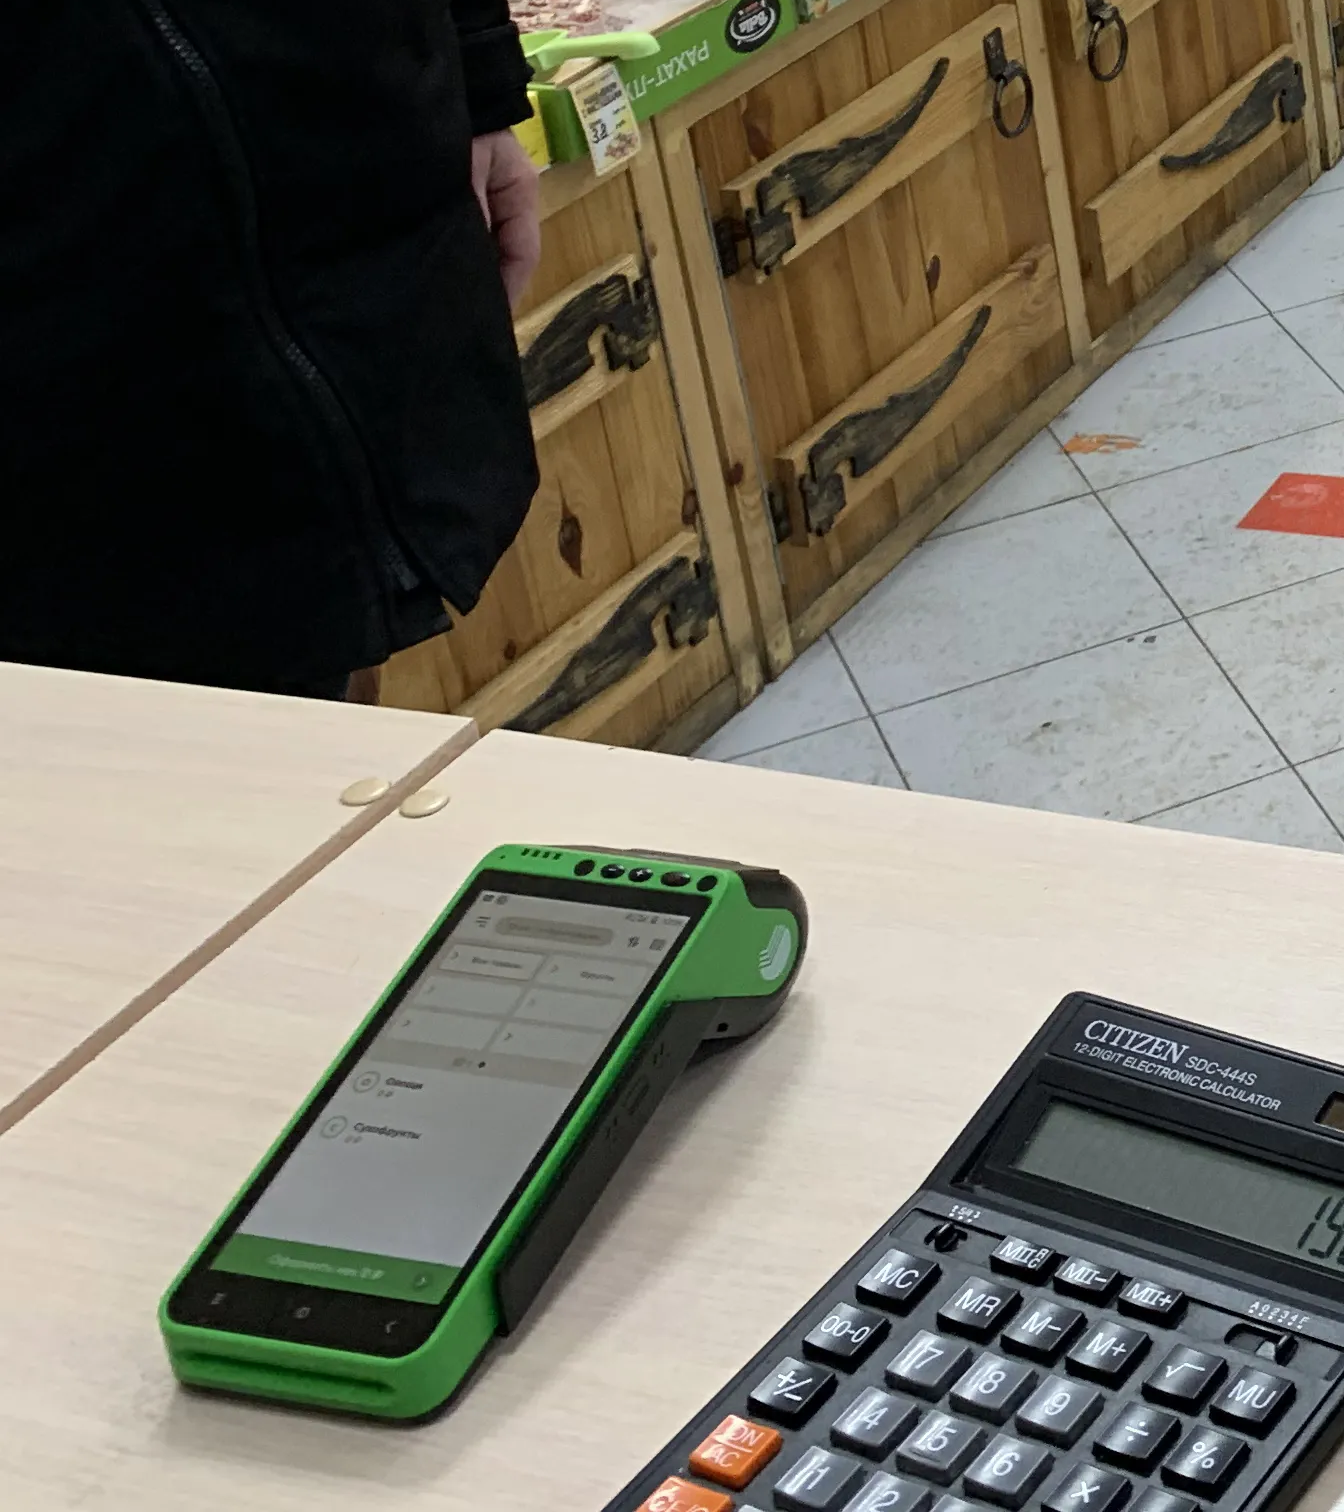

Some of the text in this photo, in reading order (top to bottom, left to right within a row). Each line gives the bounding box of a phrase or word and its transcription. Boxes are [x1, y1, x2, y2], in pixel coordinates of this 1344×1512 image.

[1083, 1019, 1258, 1087] CITIZEN SDC-444S
[1072, 1041, 1282, 1112] 12-DIGIT ELECTRONIC CALCULATOR
[875, 1262, 919, 1290] MC
[954, 1288, 1002, 1317] MR
[820, 1315, 870, 1343] 00-0
[1086, 1333, 1127, 1358] M+
[1045, 1391, 1071, 1417] 9
[1228, 1379, 1277, 1410] MU
[703, 1445, 741, 1469] AC
[992, 1450, 1021, 1477] 6
